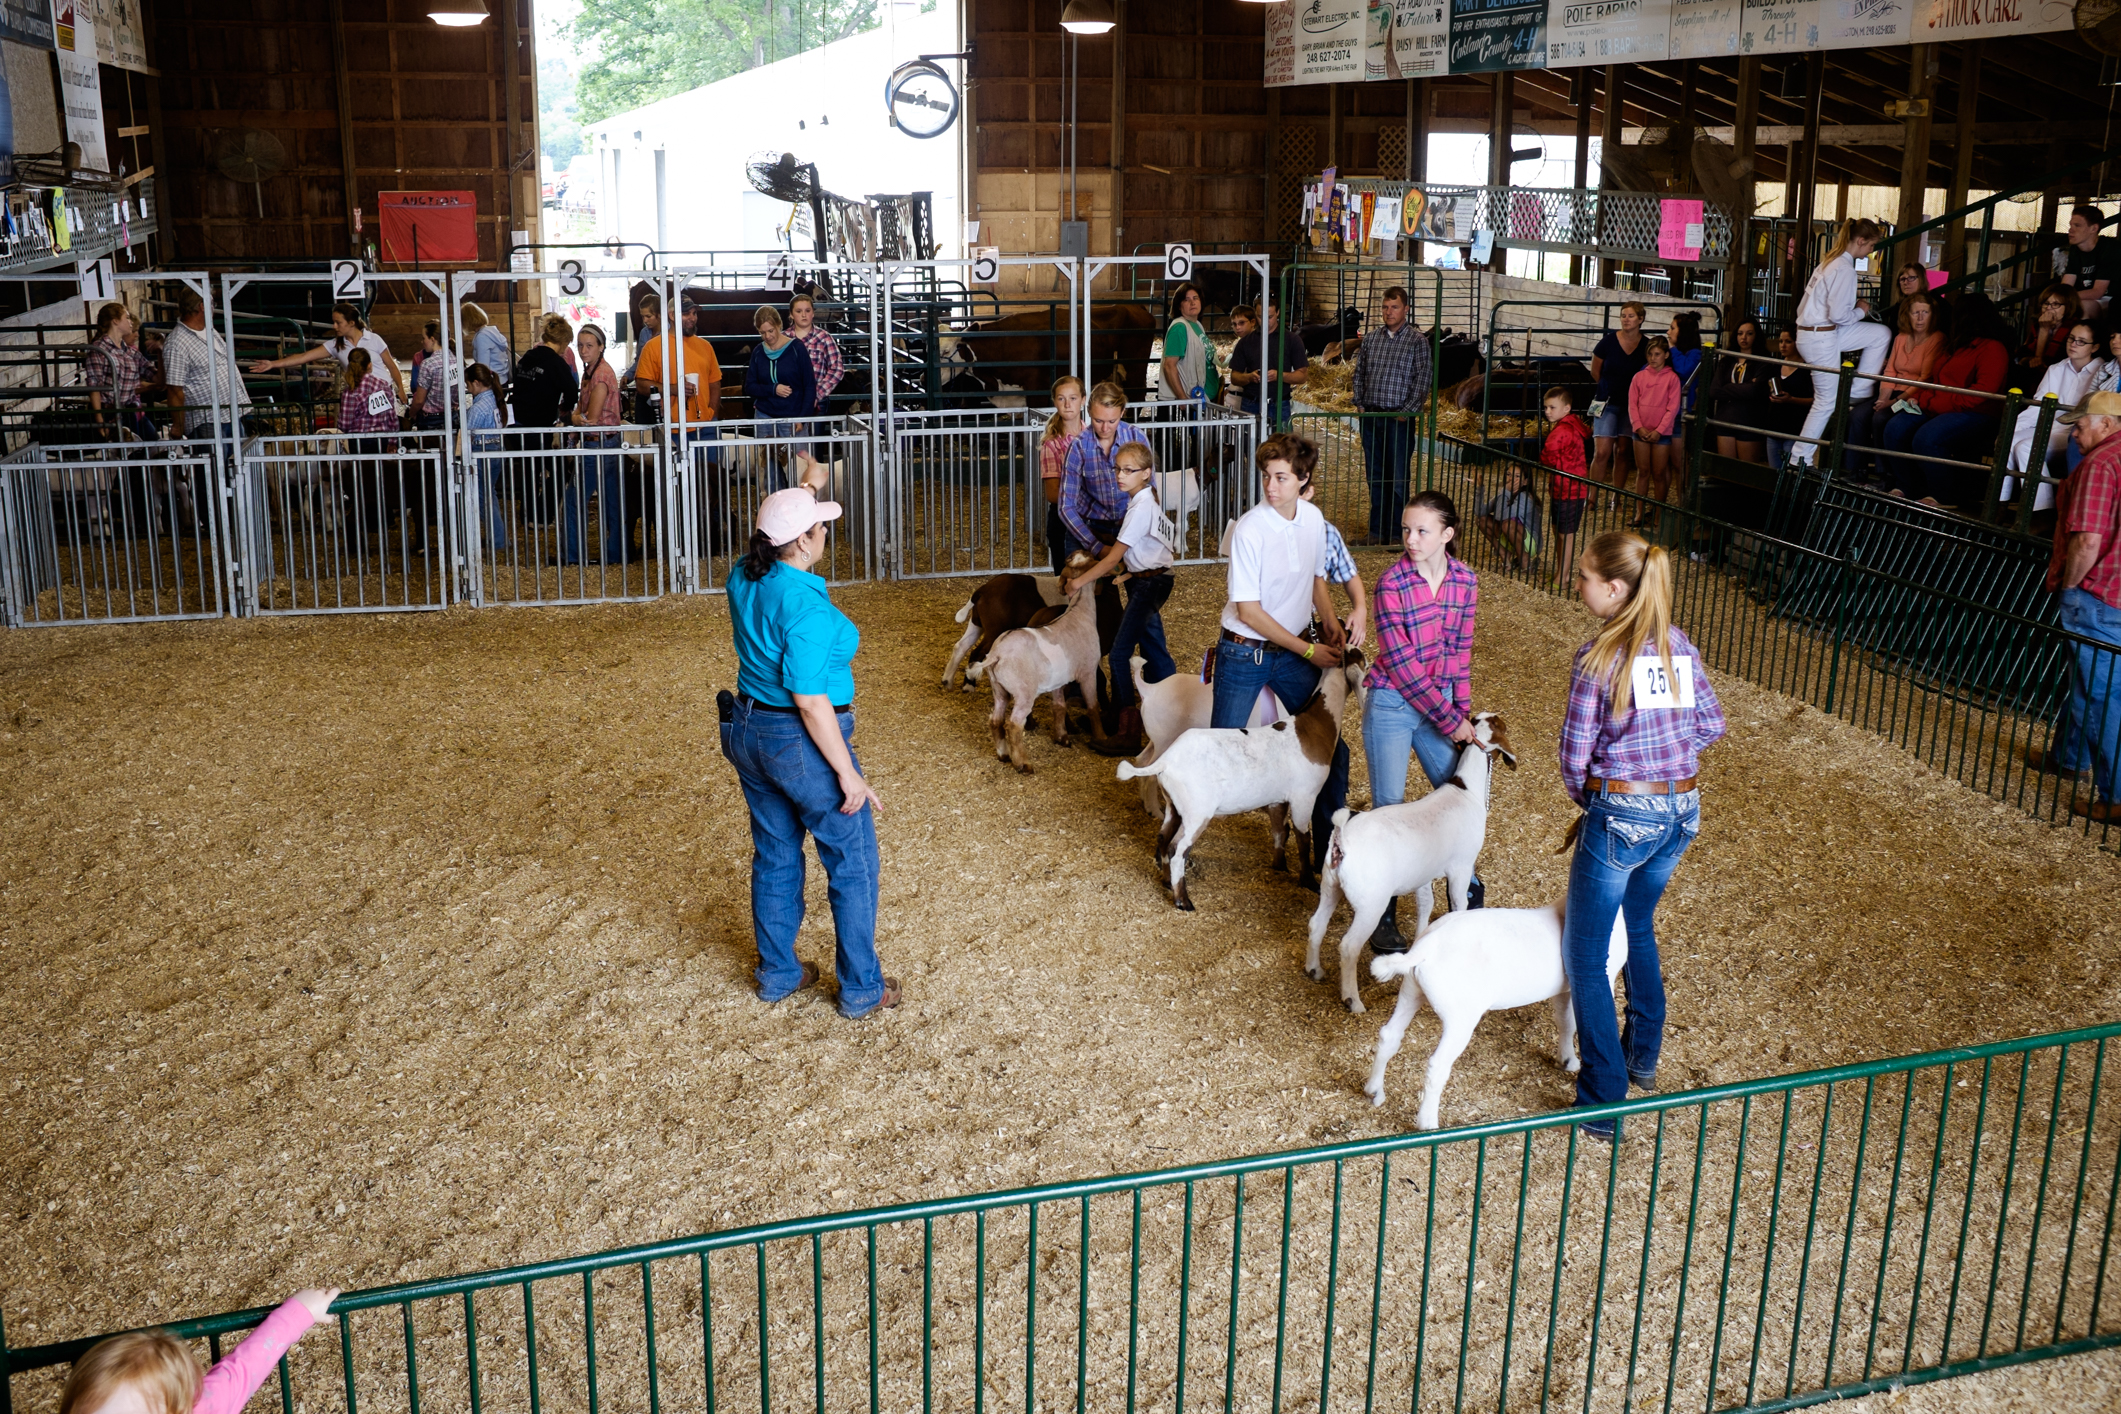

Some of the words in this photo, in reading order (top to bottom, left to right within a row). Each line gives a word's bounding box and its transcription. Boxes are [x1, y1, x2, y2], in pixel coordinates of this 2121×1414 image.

[1304, 15, 1325, 26] STEWART
[1350, 11, 1361, 19] INC.
[1402, 12, 1434, 27] Future
[1453, 21, 1463, 32] FOR
[1463, 20, 1473, 30] HER
[1475, 16, 1510, 29] ENTHUSIASTIC
[1511, 12, 1533, 25] SUPPORT
[1535, 12, 1543, 22] OF
[1566, 6, 1592, 24] POLE
[1596, 1, 1638, 20] BARNS
[1675, 11, 1707, 28] Supplying
[1708, 9, 1719, 23] all
[1762, 8, 1797, 23] Through
[1763, 22, 1797, 45] 4-H
[1866, 26, 1874, 35] 248
[1875, 24, 1896, 35] 625-8085
[1302, 44, 1312, 52] GARY,
[1313, 42, 1326, 51] BRIAN
[1326, 41, 1335, 49] AND
[1335, 40, 1344, 48] THE
[1345, 38, 1358, 47] GUYS
[1396, 38, 1413, 52] DAISY
[1415, 36, 1428, 49] HILL
[1431, 34, 1447, 48] FARM
[1451, 32, 1487, 63] Oakland
[1479, 34, 1513, 63] County
[1513, 27, 1540, 50] 4-H
[1551, 43, 1560, 59] 586
[1599, 39, 1612, 56] 888
[1307, 53, 1318, 63] 248
[1319, 49, 1351, 62] 627-2074
[1512, 52, 1546, 64] AGRICULTURE
[401, 196, 459, 206] AUCTION
[767, 255, 791, 288] 4
[975, 248, 996, 281] 5
[1168, 246, 1190, 278] 6
[85, 260, 101, 298] 1
[335, 261, 361, 297] 2
[561, 261, 584, 295] 3
[1158, 515, 1171, 542] 2848
[1648, 667, 1681, 694] 251
